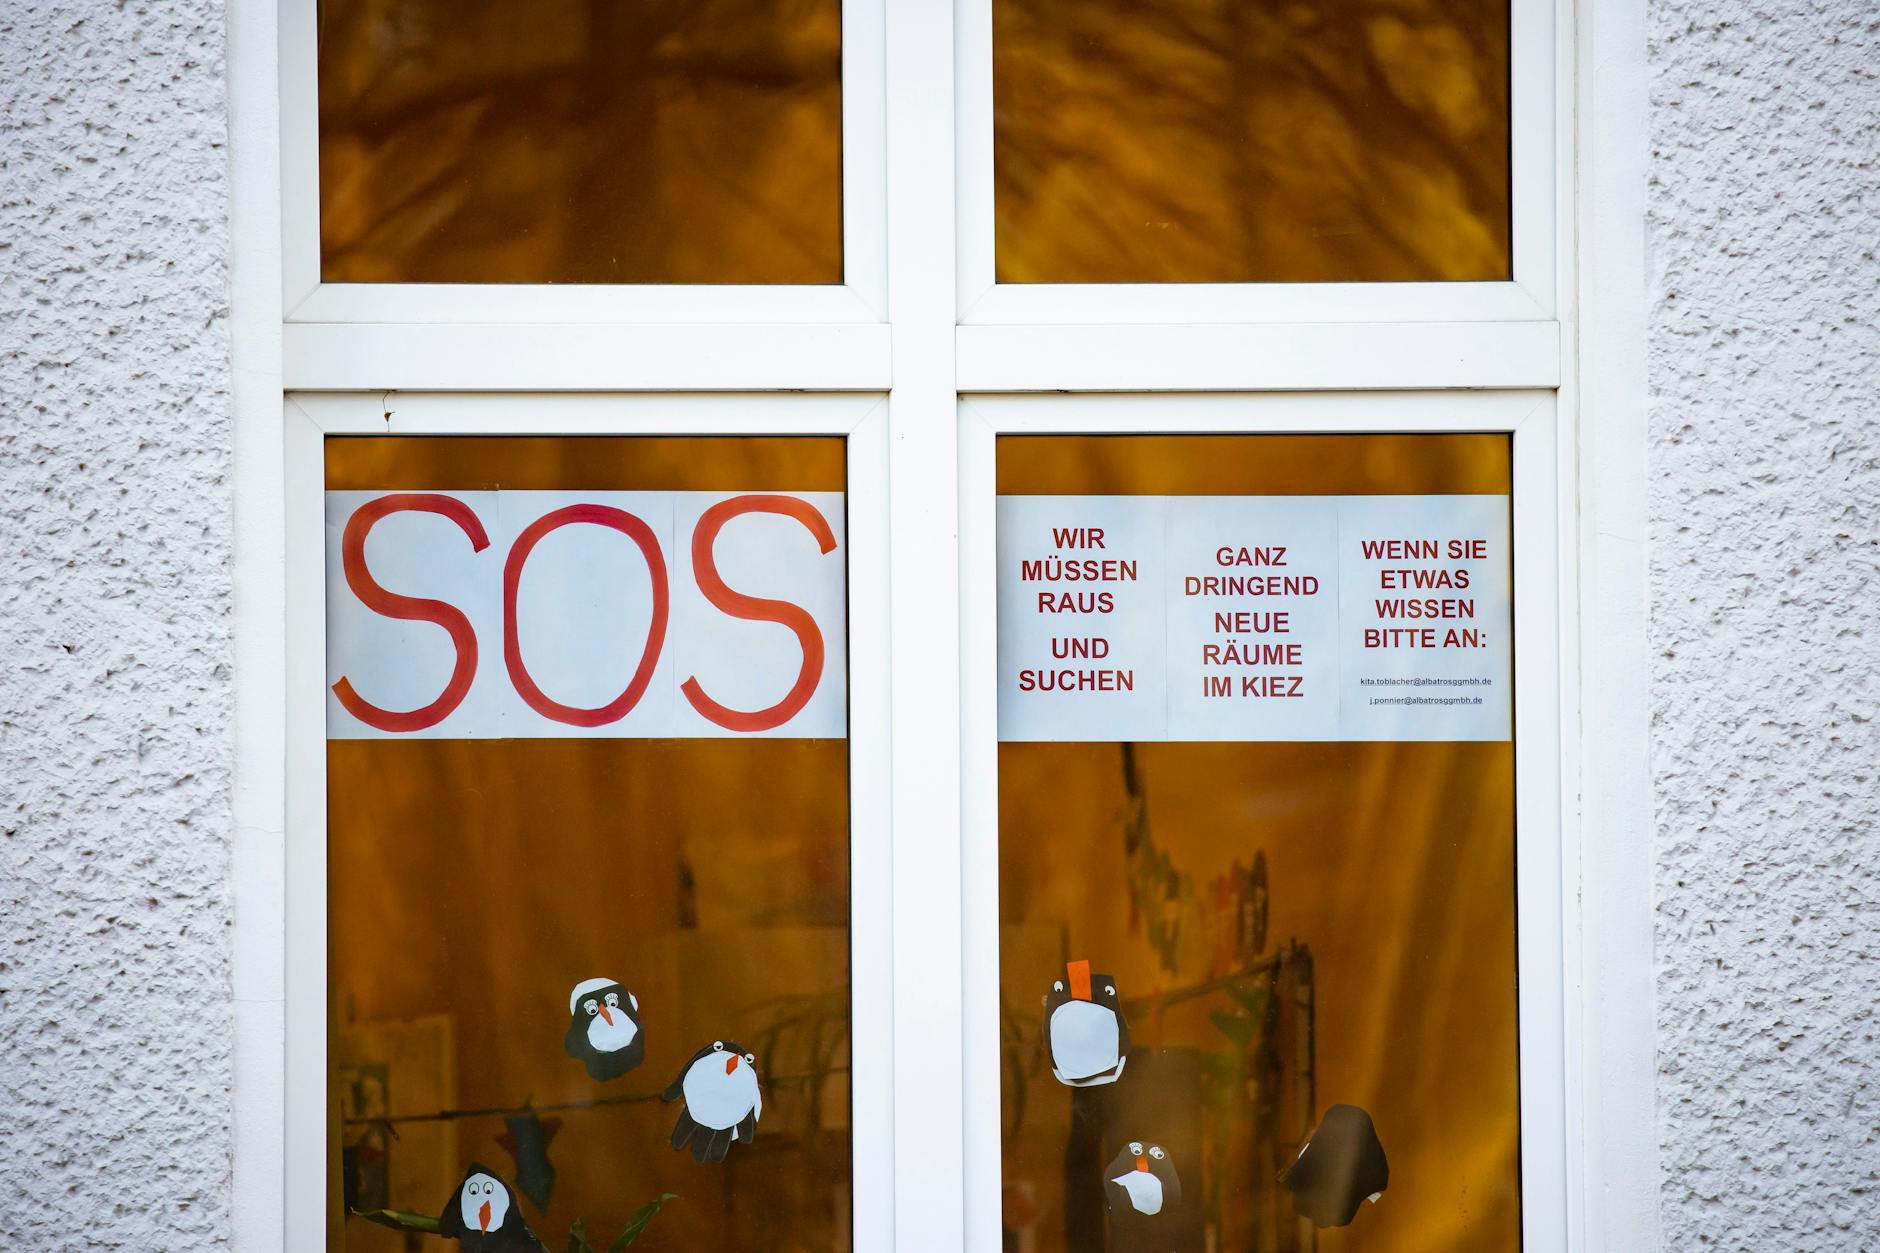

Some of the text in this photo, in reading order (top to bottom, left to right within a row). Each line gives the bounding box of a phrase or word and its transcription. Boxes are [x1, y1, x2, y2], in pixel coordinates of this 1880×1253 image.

[1052, 527, 1106, 549] WIR
[1216, 546, 1288, 567] GANZ
[1361, 539, 1488, 560] WENN SIE
[1021, 554, 1138, 582] MÜSSEN
[1184, 576, 1320, 596] DRINGEND
[1381, 569, 1470, 590] ETWAS
[331, 493, 838, 733] SOS
[1038, 591, 1115, 614] RAUS
[1375, 598, 1475, 619] WISSEN
[1214, 612, 1290, 634] NEUE
[1051, 637, 1109, 660] UND
[1363, 628, 1488, 649] BITTE AN:
[1202, 639, 1303, 666] RÄUME
[1018, 669, 1134, 692] SUCHEN
[1202, 676, 1305, 698] IM KIEZ
[1360, 677, 1492, 687] kita.toblacher@albatrosggmbh.de
[1369, 696, 1483, 706] j.ponnier@albatrosggmbh.de
